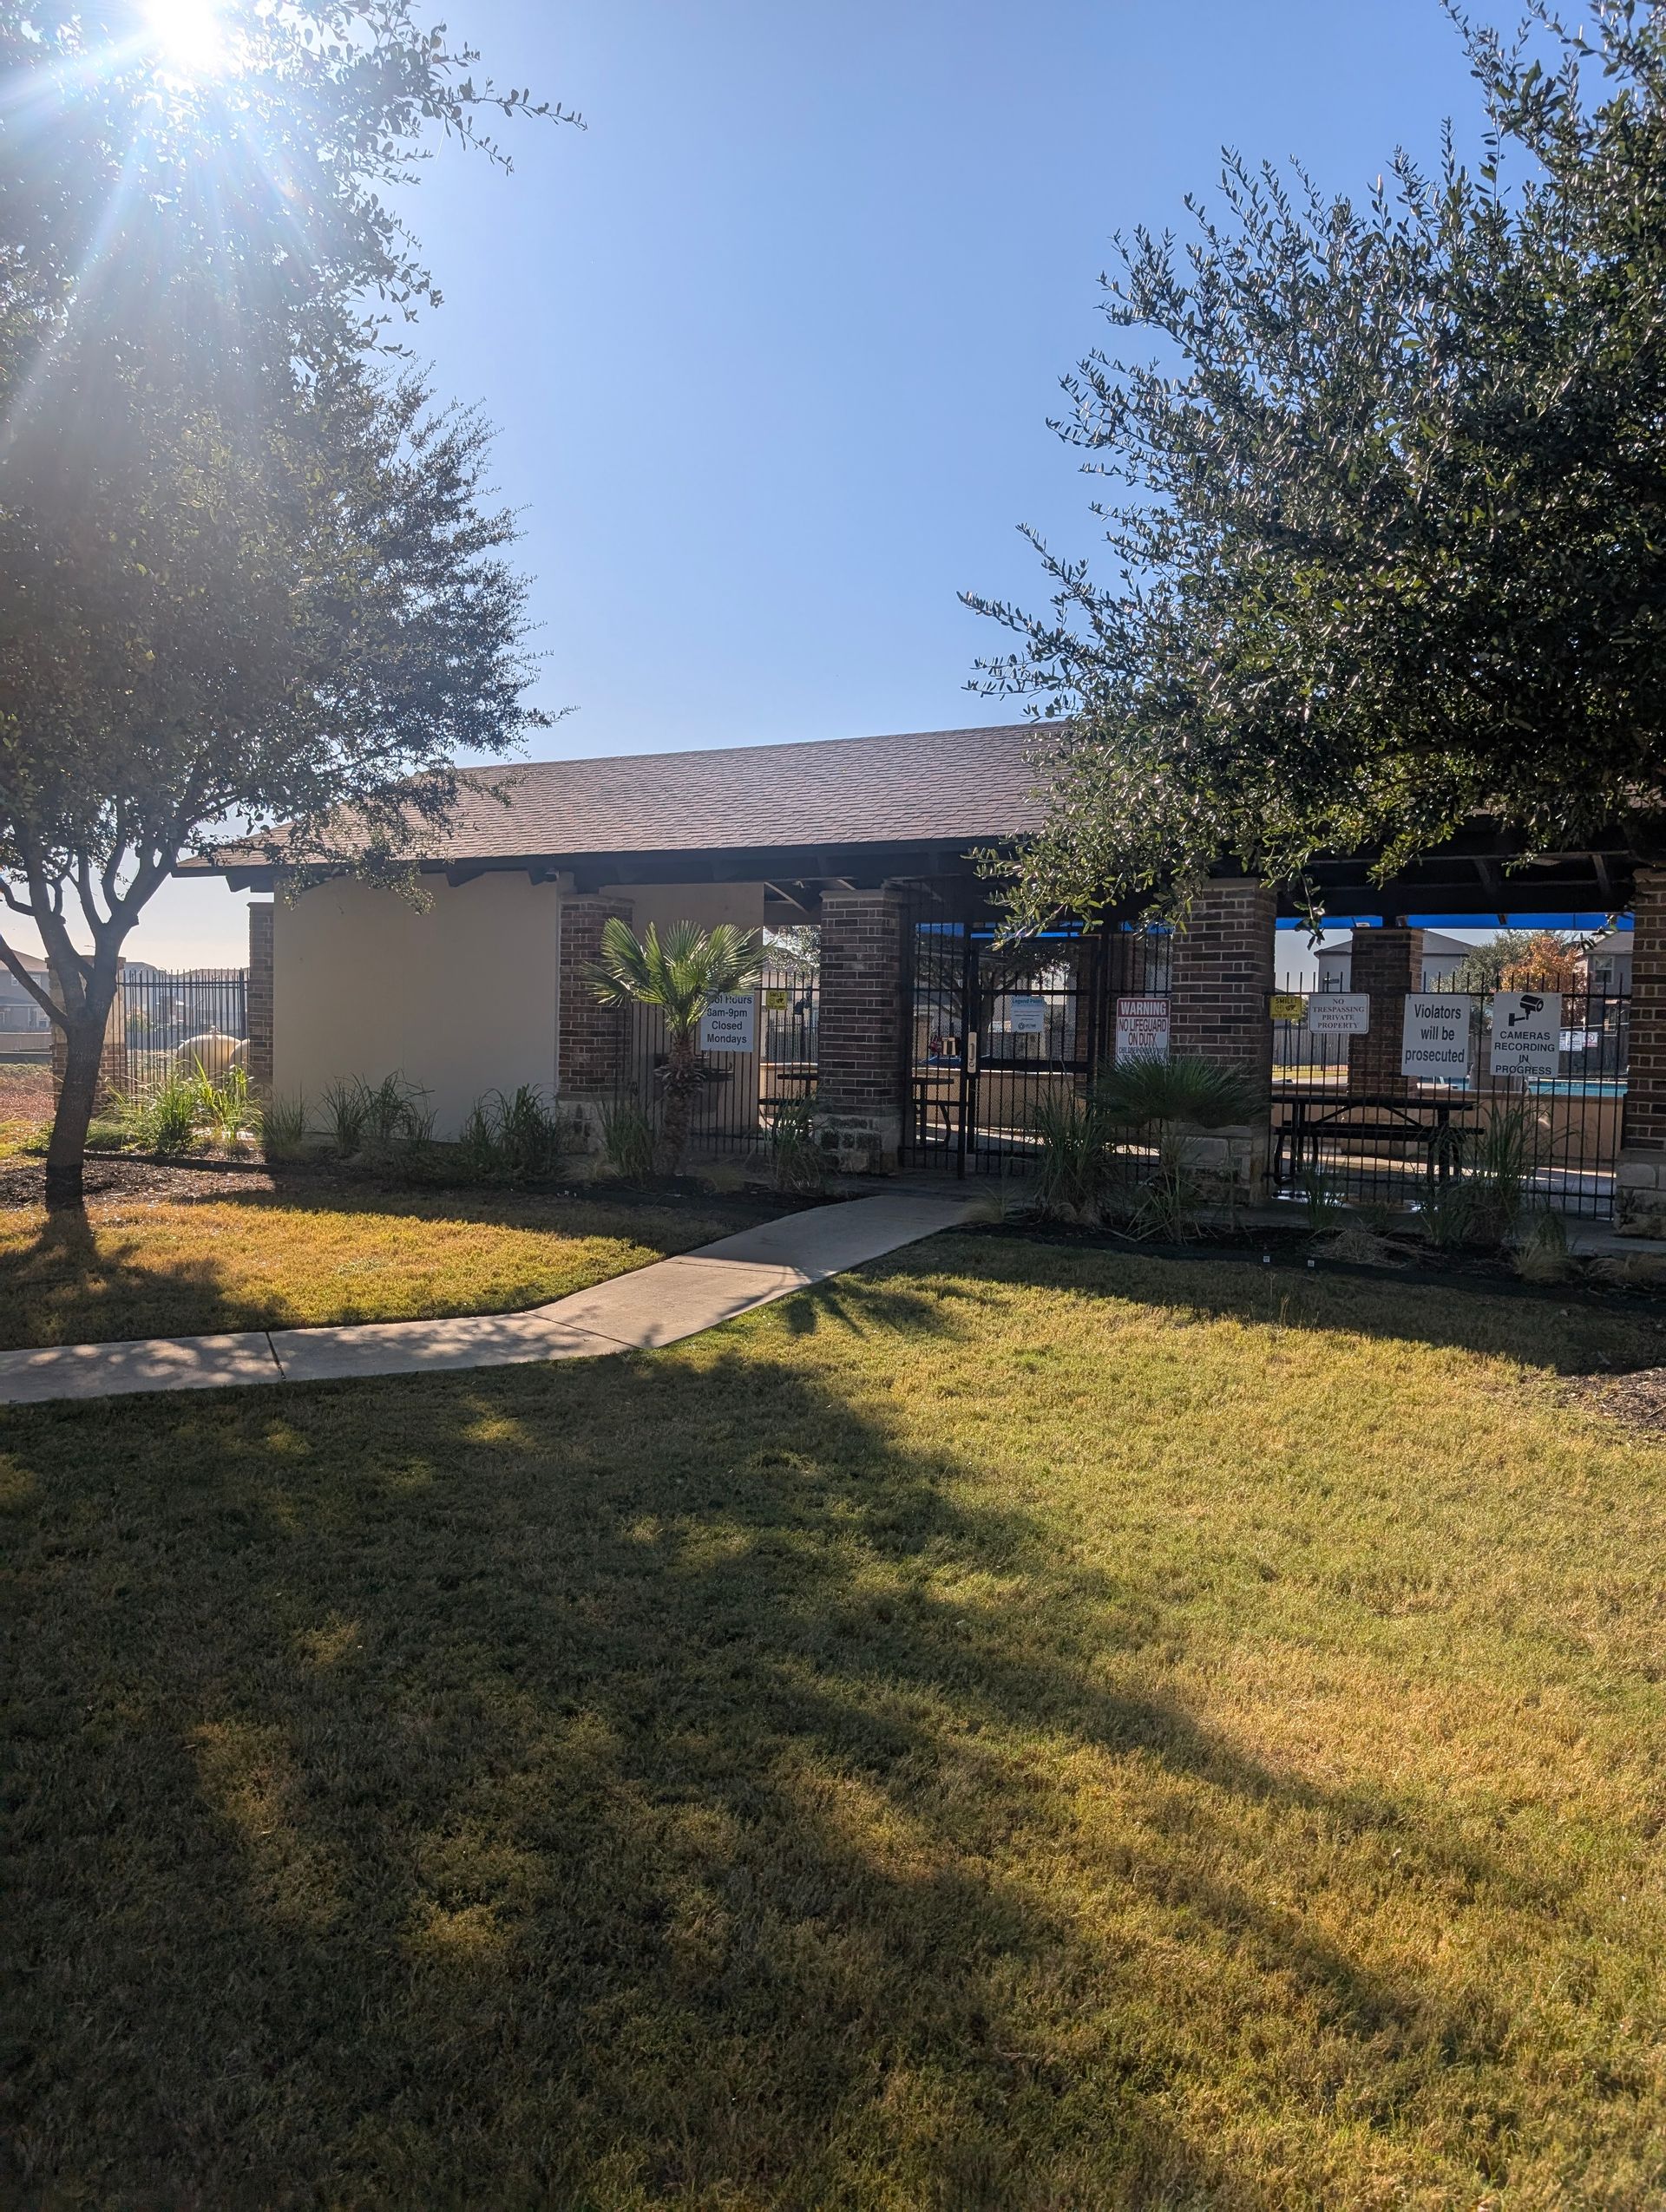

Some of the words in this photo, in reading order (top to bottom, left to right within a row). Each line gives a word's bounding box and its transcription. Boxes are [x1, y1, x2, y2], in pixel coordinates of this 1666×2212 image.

[1120, 1001, 1167, 1016] WARNING
[1414, 1004, 1461, 1019] Violators
[712, 1020, 743, 1031] Closed
[1119, 1018, 1129, 1031] NO
[1130, 1018, 1167, 1032] LIFEGUARD
[707, 1033, 747, 1045] Mondays
[1129, 1032, 1138, 1046] ON
[1138, 1032, 1157, 1046] DUTY
[1420, 1025, 1439, 1040] will
[1441, 1026, 1454, 1040] be
[1499, 1031, 1551, 1040] CAMERAS
[1494, 1042, 1555, 1052] RECORDING
[1405, 1049, 1465, 1064] prosecuted
[1518, 1054, 1529, 1063] IN
[1495, 1064, 1551, 1075] PROGRESS
